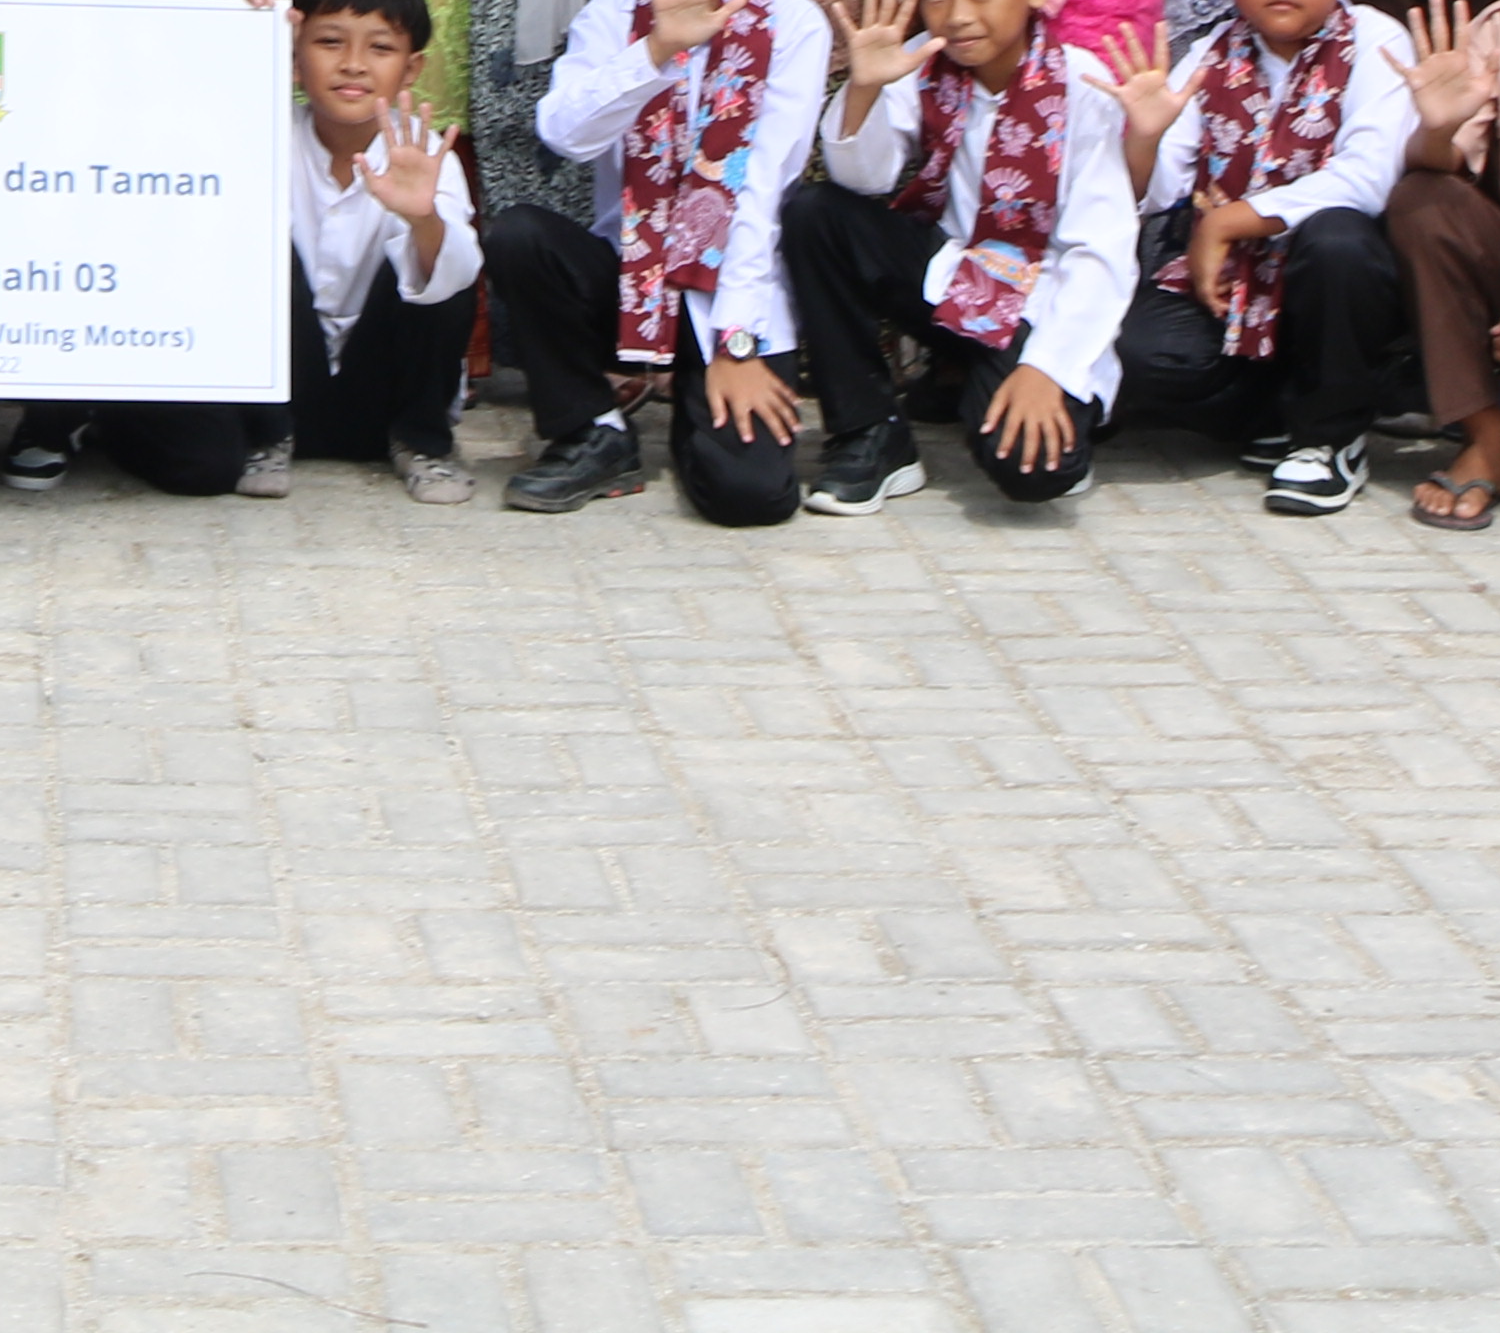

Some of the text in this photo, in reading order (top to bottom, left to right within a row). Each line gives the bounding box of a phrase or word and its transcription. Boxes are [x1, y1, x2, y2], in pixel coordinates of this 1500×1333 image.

[4, 161, 75, 193] dan
[88, 164, 221, 197] Taman
[74, 262, 118, 293] 03
[84, 324, 195, 351] Motors)
